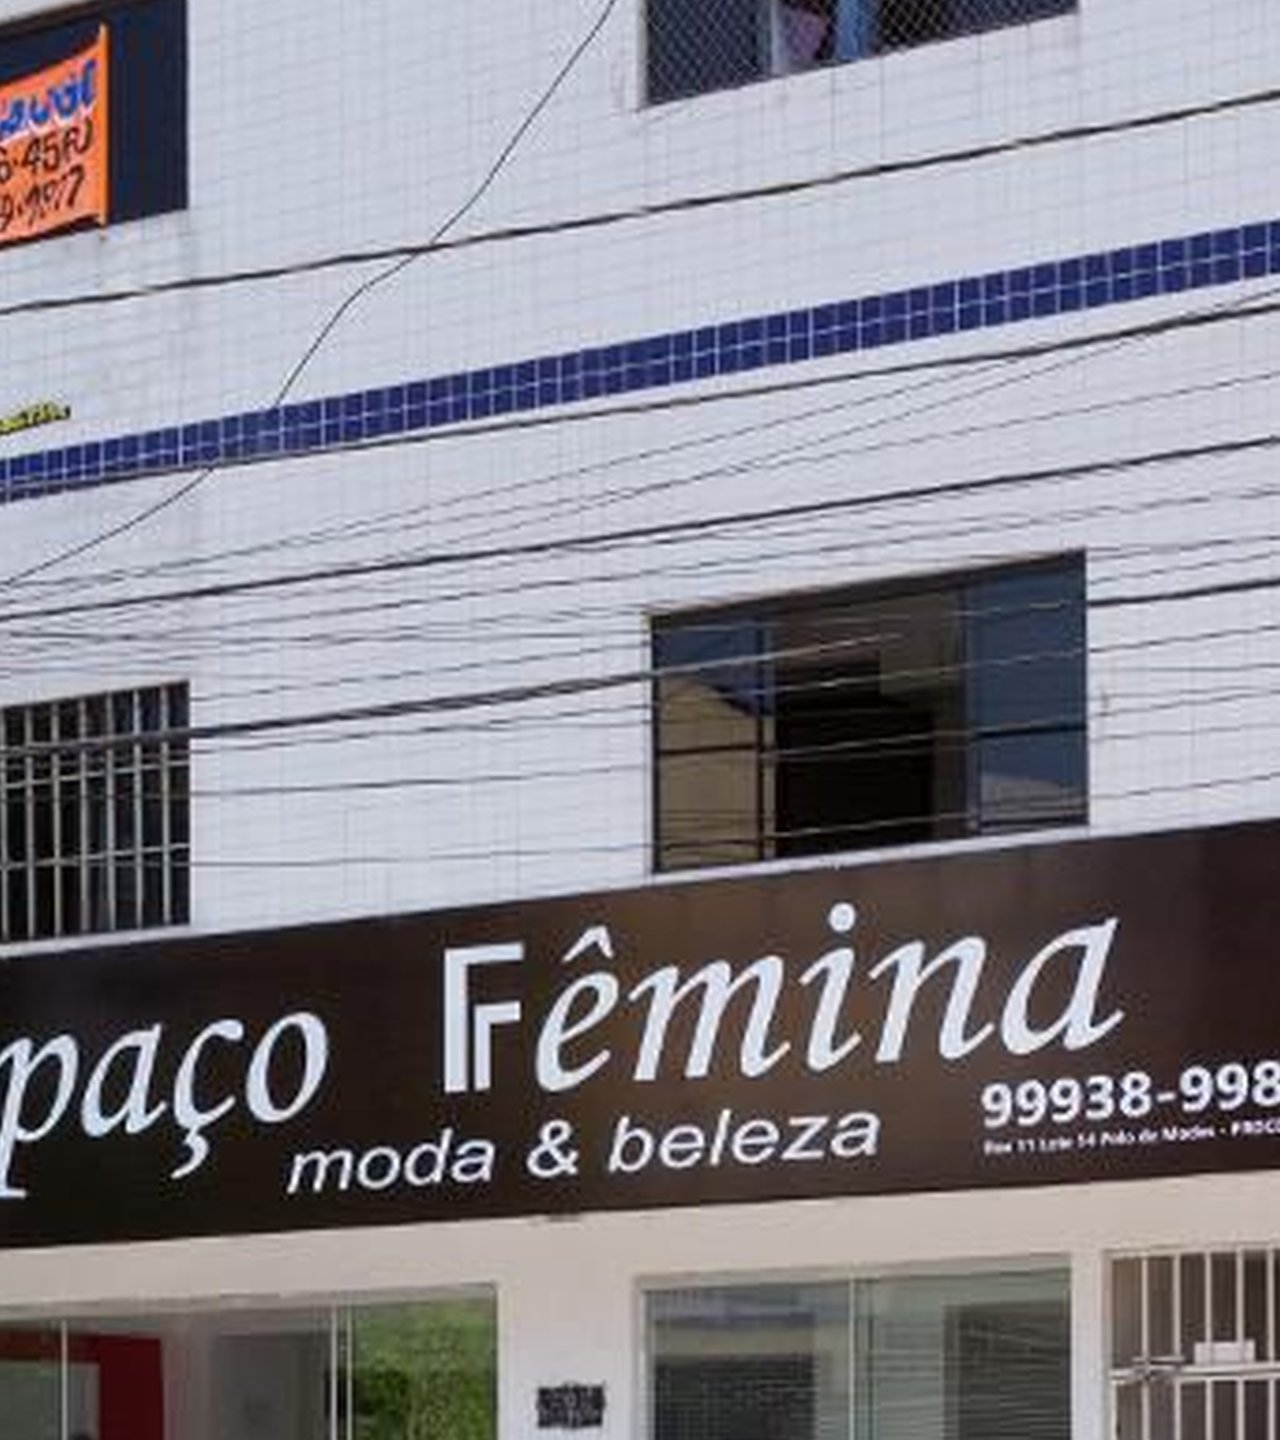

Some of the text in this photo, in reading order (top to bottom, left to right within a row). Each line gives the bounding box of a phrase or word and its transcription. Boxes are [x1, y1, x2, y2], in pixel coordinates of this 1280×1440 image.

[443, 902, 1126, 1094] Fêmina
[287, 1108, 882, 1196] moda & beleza
